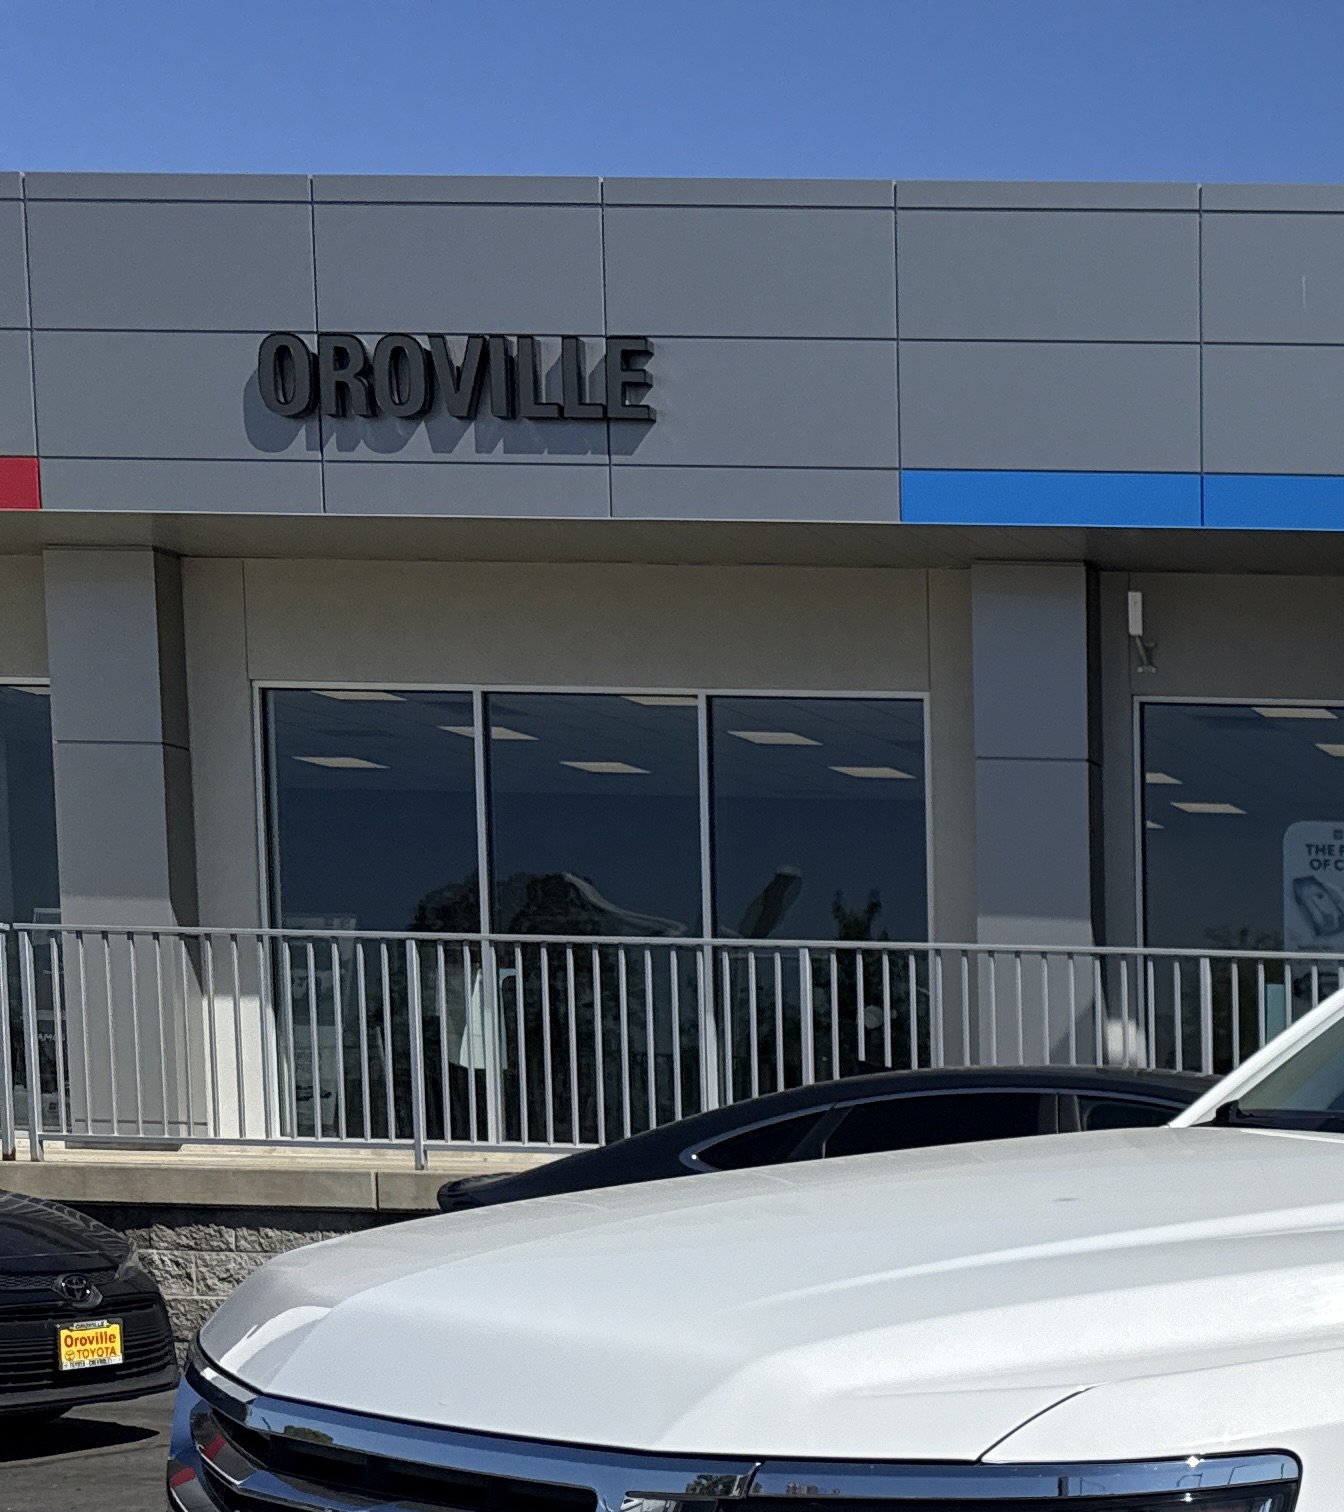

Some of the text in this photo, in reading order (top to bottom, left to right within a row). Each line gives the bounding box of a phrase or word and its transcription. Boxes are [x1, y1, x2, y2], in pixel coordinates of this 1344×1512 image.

[257, 331, 657, 423] OROVILLE
[1305, 843, 1336, 857] THE
[1309, 858, 1331, 872] OF
[64, 1331, 116, 1348] Oroville
[76, 1346, 117, 1359] TOYOTA
